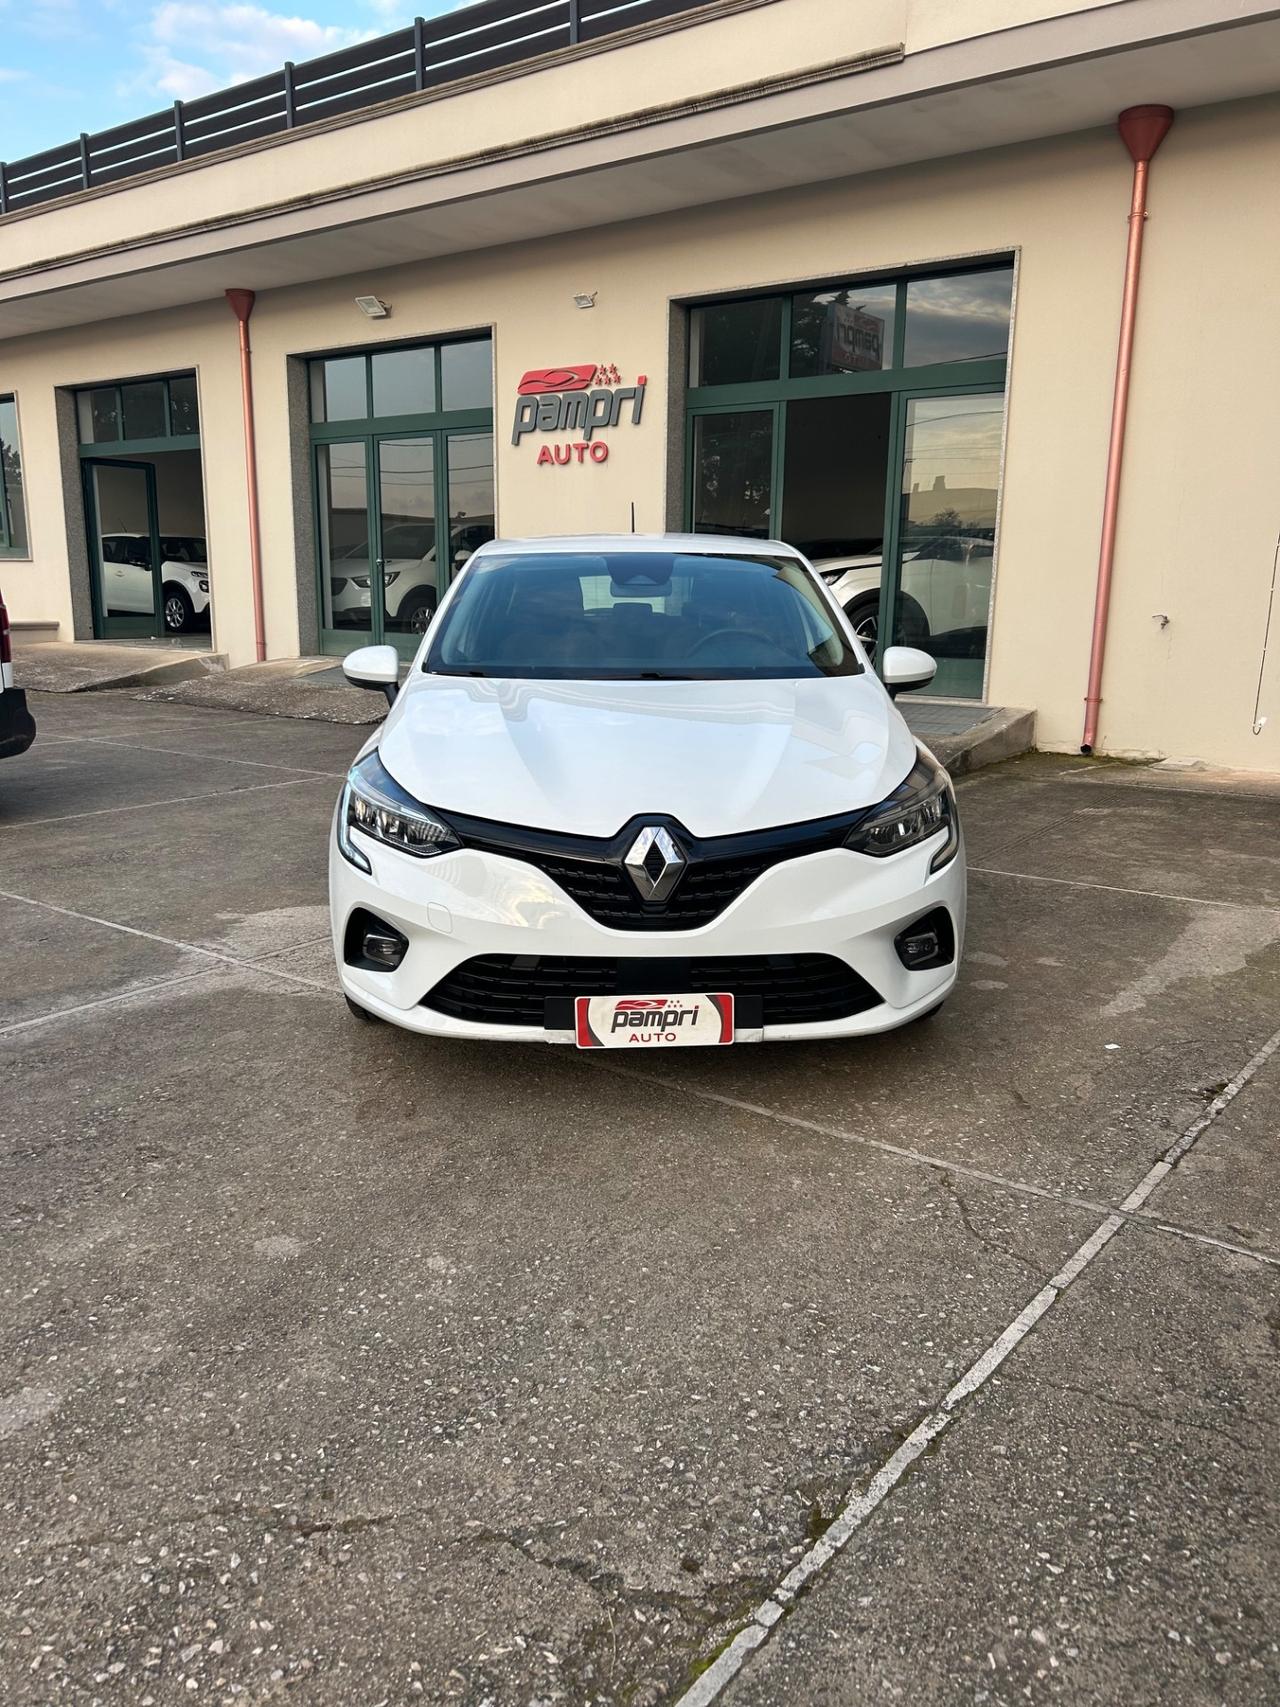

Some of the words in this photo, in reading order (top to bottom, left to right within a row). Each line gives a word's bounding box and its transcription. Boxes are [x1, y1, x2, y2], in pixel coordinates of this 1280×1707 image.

[511, 375, 647, 446] pampri
[537, 441, 609, 465] AUTO
[611, 1005, 699, 1033] pampri
[629, 1033, 676, 1043] AUTO
